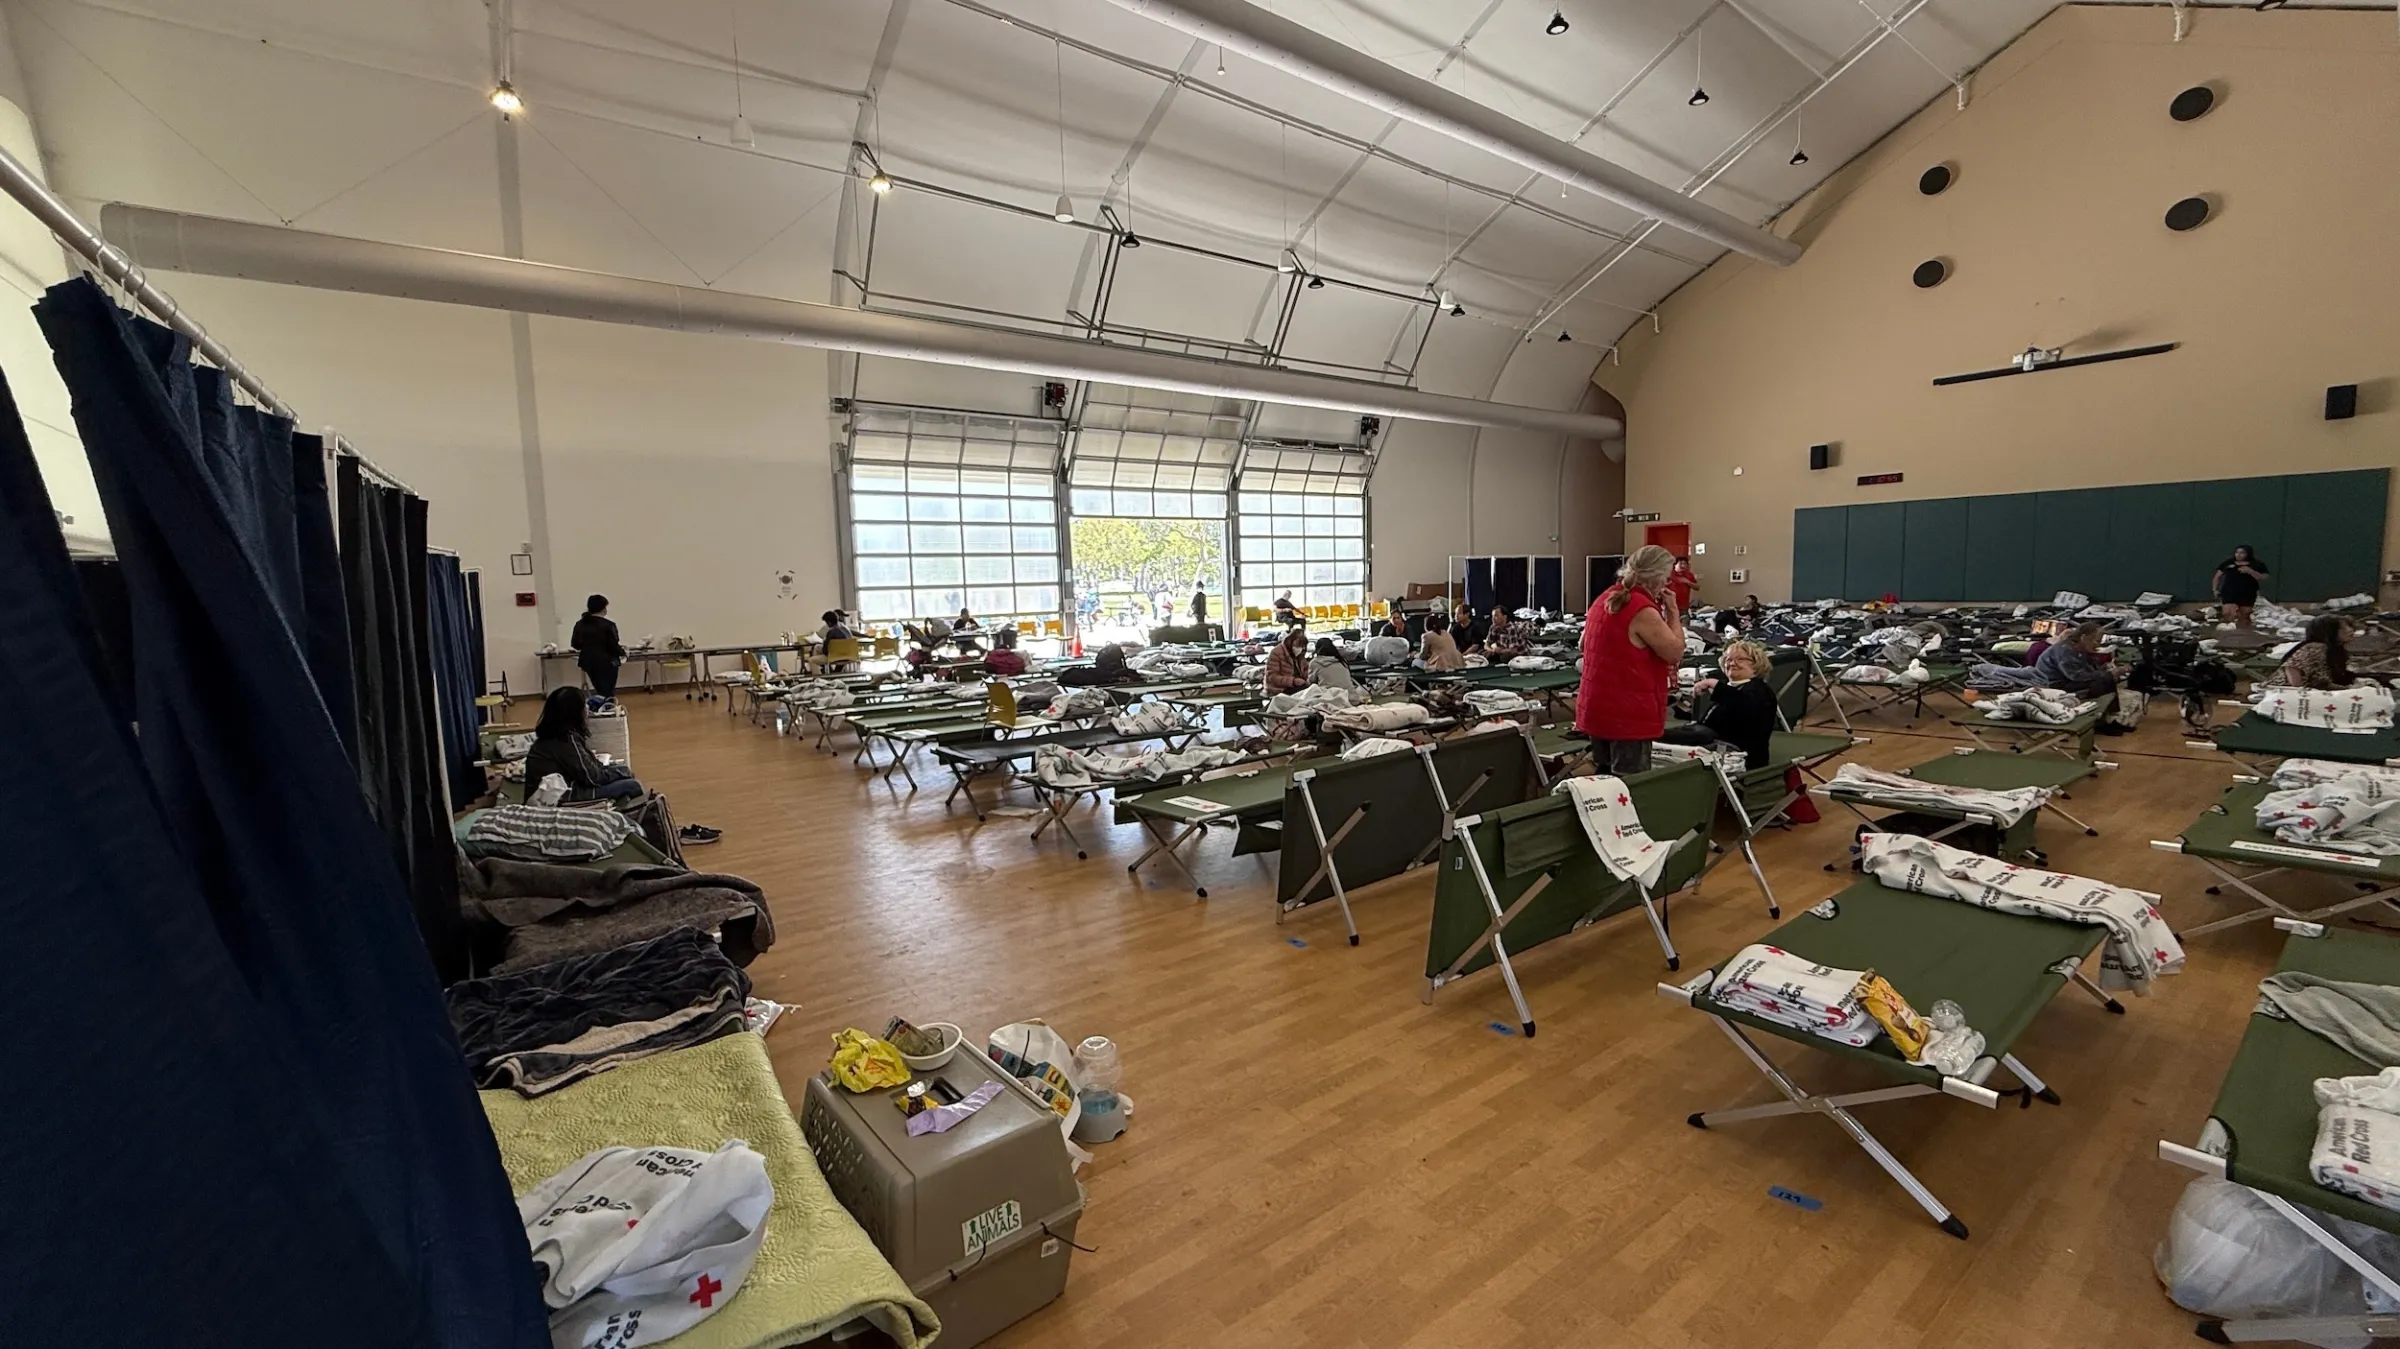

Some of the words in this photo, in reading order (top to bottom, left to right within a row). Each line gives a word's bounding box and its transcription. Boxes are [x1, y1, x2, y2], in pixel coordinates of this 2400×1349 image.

[1583, 796, 1605, 806] erican
[1621, 823, 1641, 832] Americ
[1905, 863, 1919, 892] erican
[2349, 1119, 2370, 1142] Cross
[2351, 1141, 2372, 1165] Red
[979, 1206, 1005, 1230] LIVE
[967, 1213, 1020, 1253] ANIMALS
[612, 1309, 642, 1349] ross
